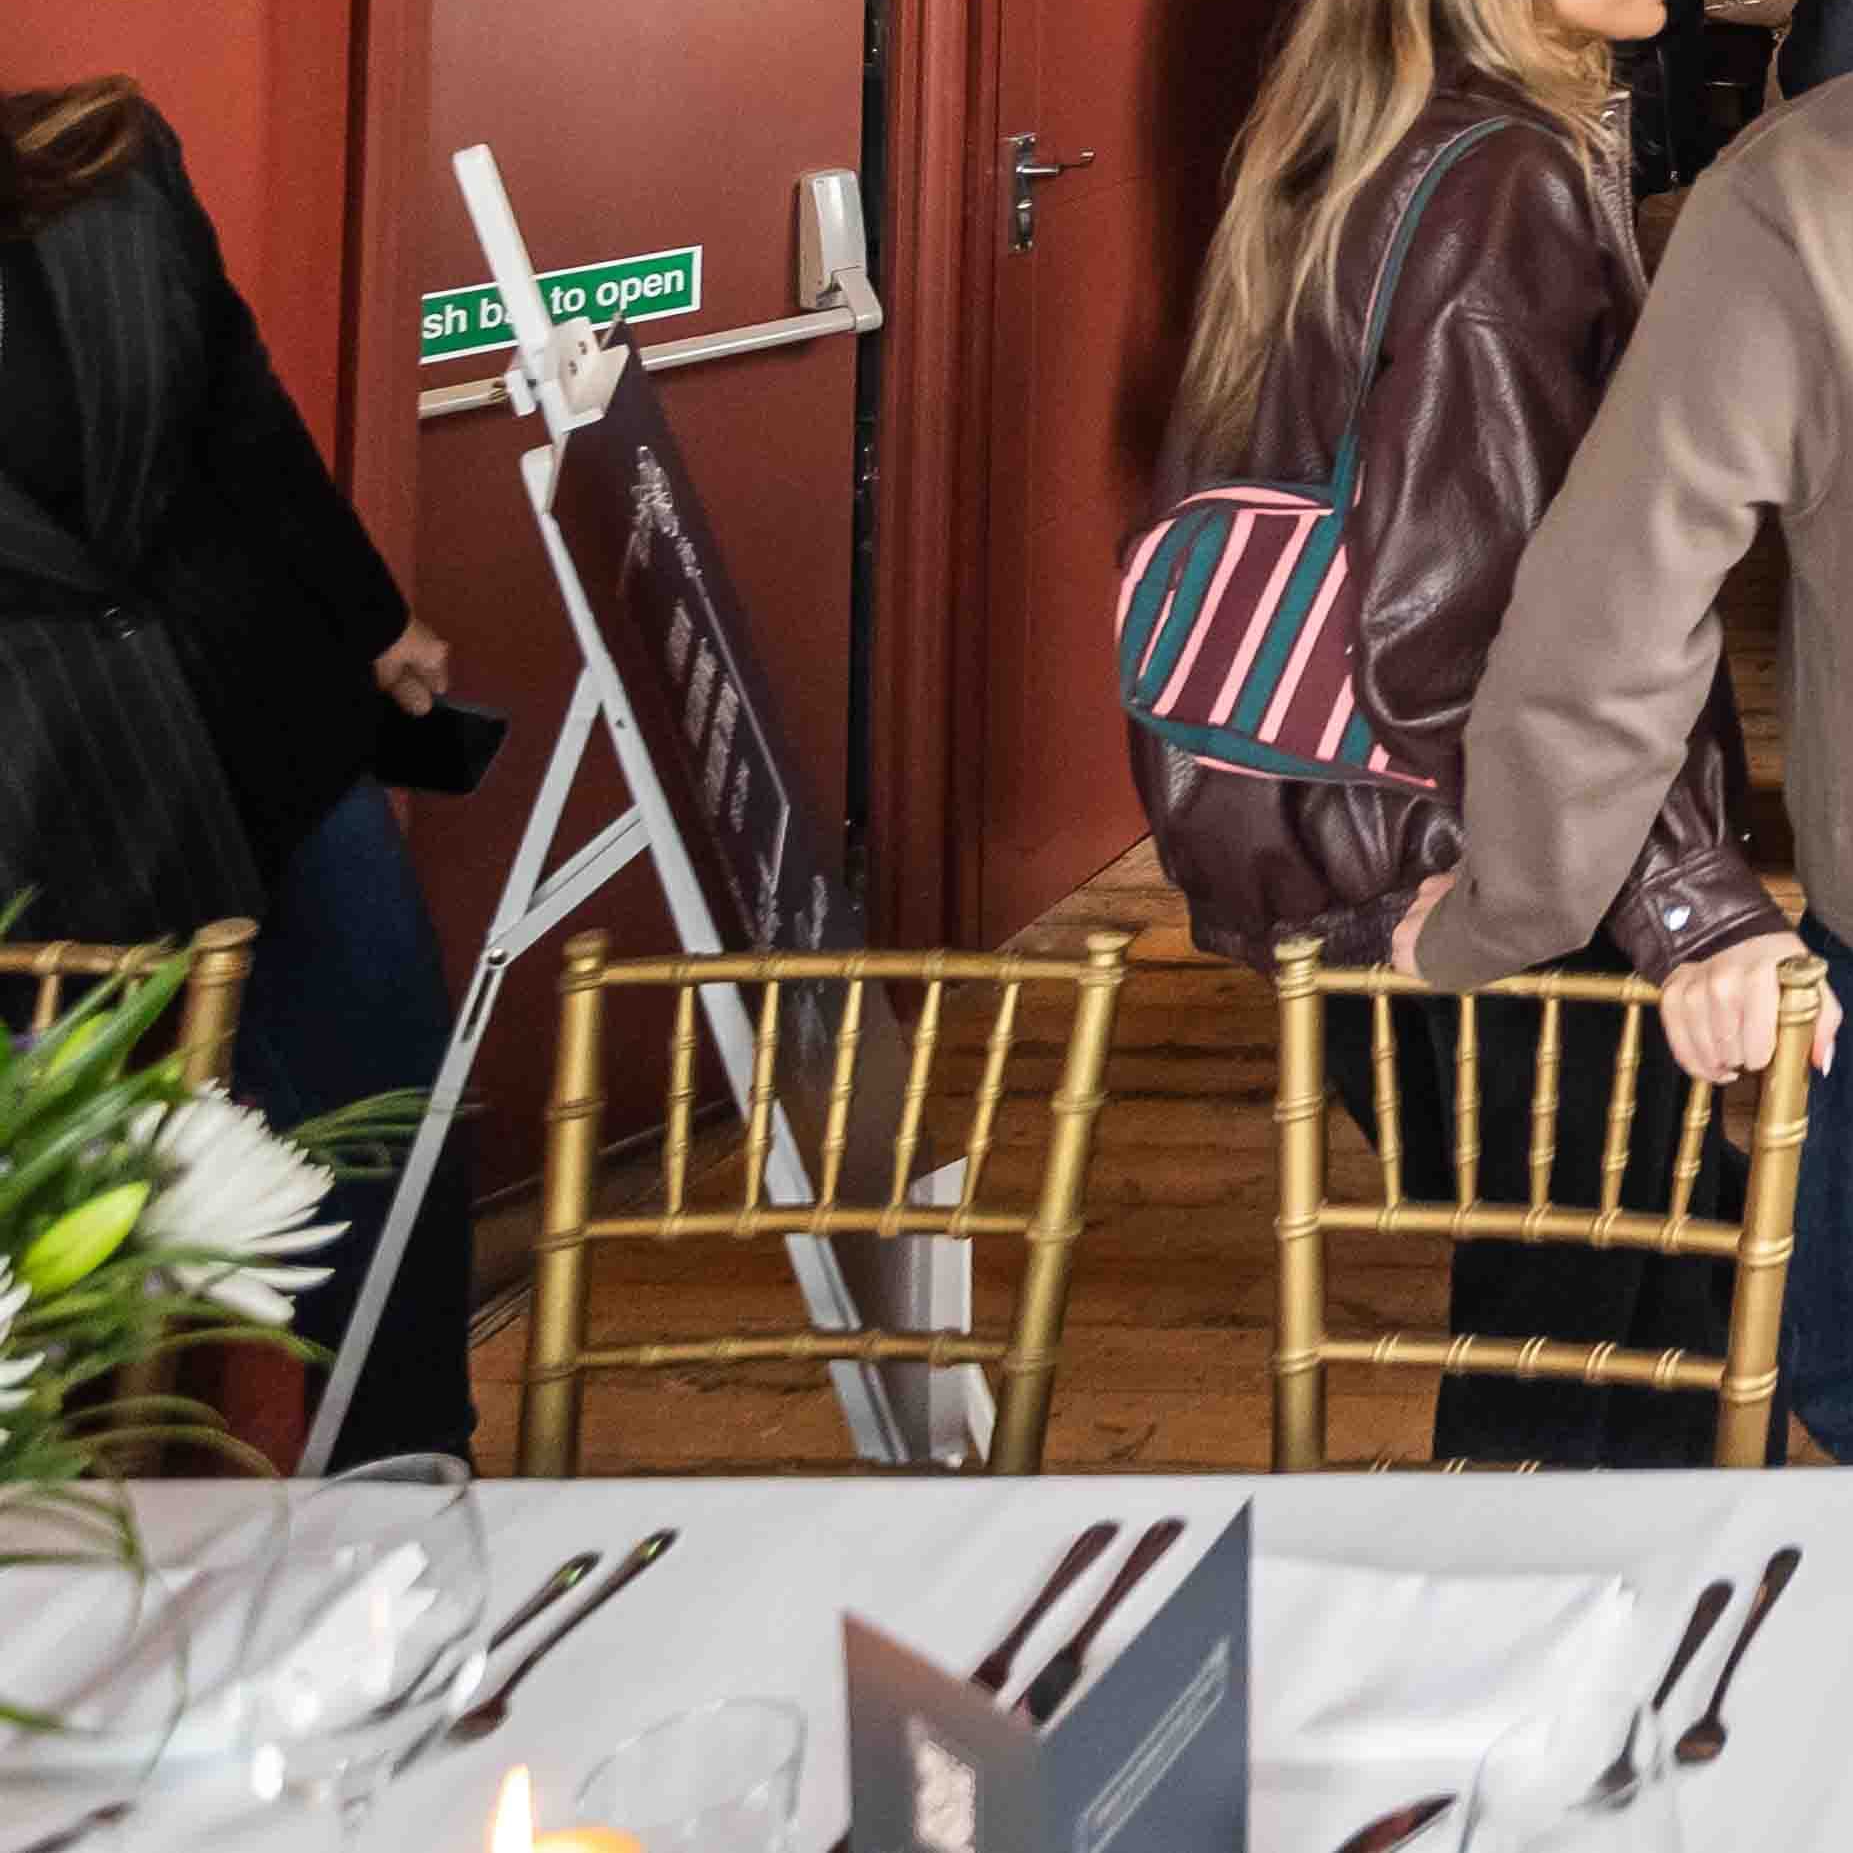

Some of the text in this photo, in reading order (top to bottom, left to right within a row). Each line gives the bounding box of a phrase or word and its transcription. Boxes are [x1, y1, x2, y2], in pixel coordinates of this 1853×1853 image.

[421, 303, 468, 340] sh
[550, 285, 586, 316] to
[595, 268, 686, 311] open
